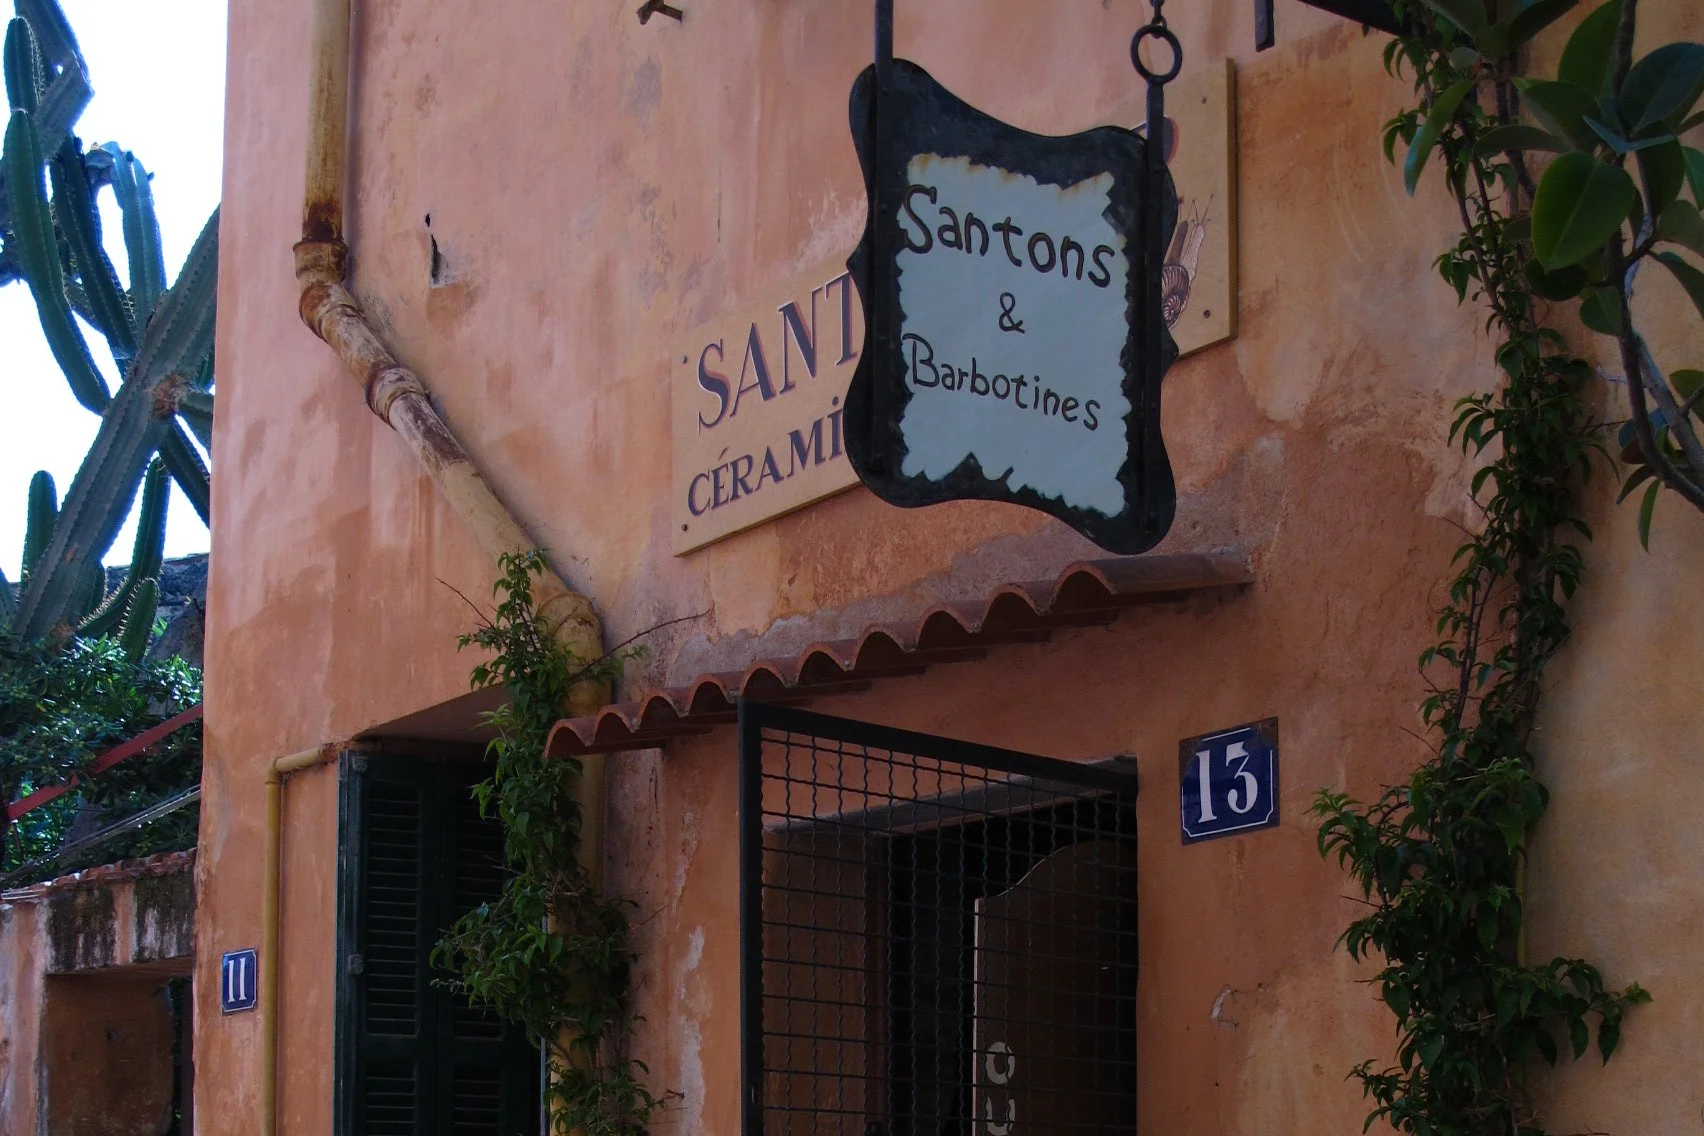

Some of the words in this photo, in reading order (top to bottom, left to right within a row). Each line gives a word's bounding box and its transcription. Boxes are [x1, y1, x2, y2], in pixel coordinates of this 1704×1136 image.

[901, 184, 1115, 288] Santons
[998, 292, 1026, 334] &
[901, 333, 1101, 431] Barbotines
[1195, 741, 1258, 824] 13
[228, 957, 247, 1003] 11
